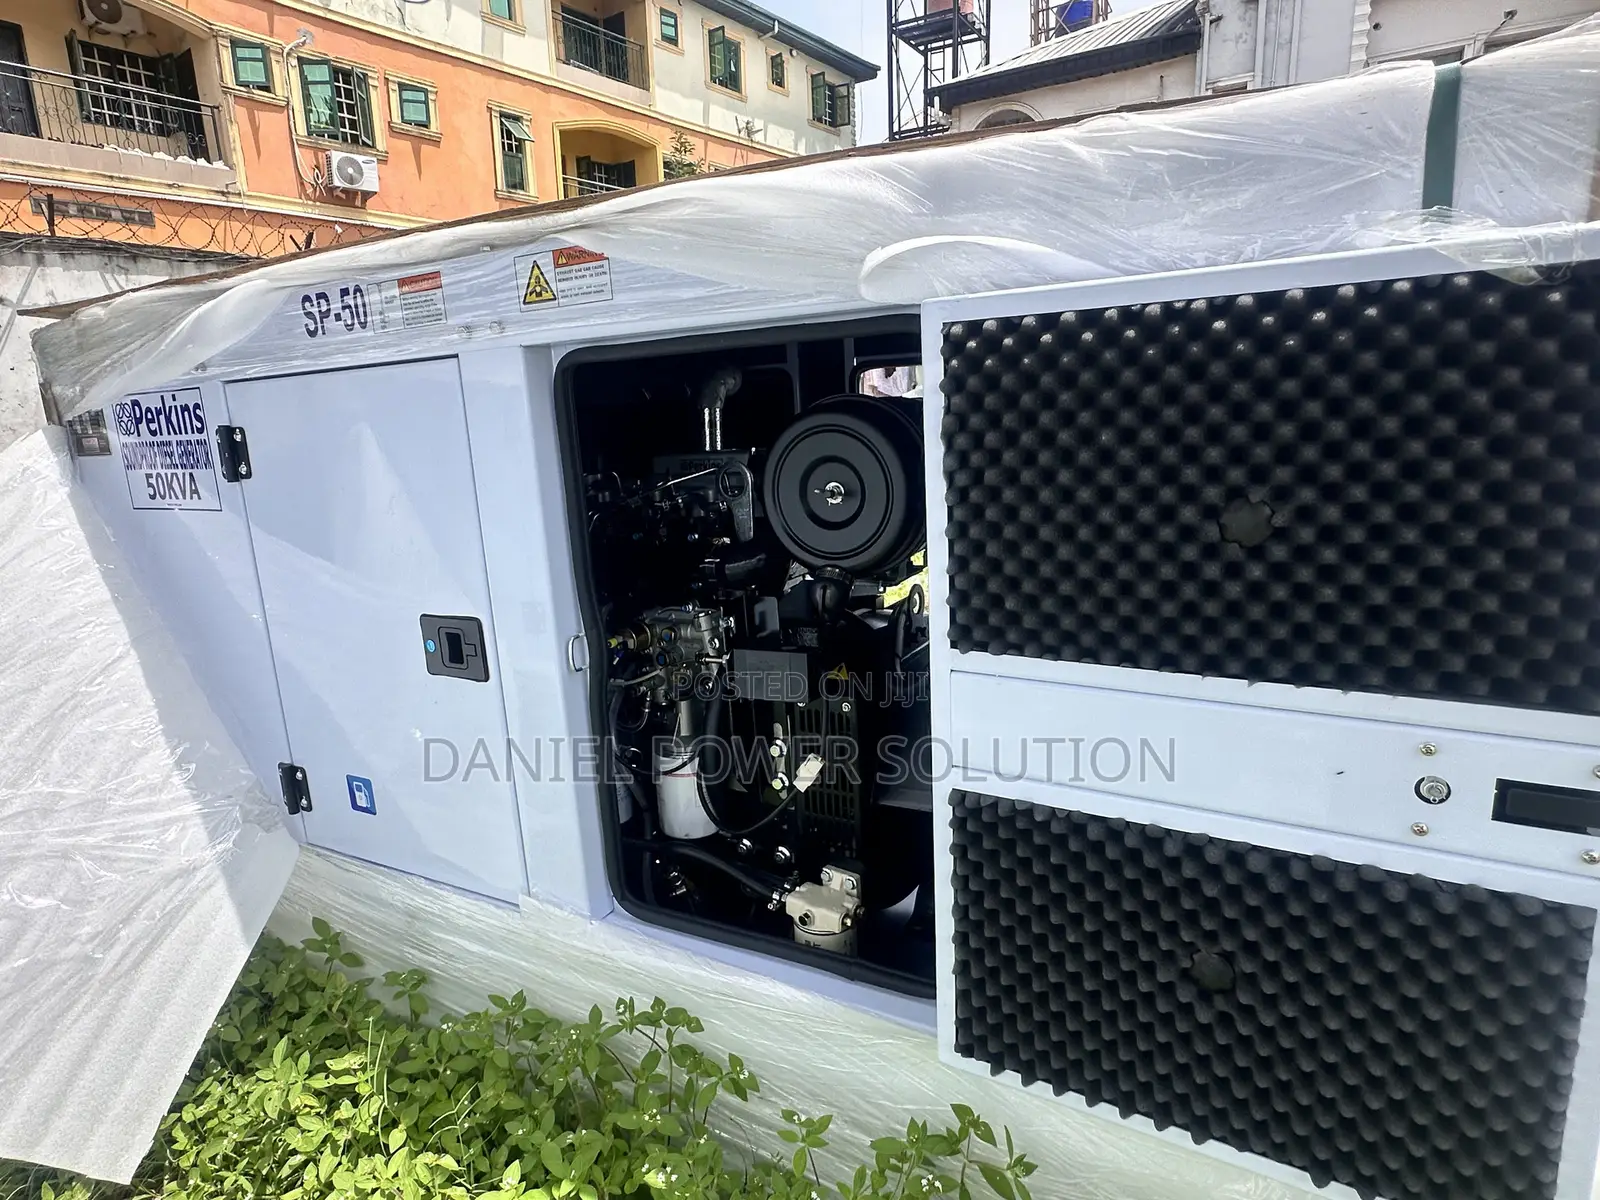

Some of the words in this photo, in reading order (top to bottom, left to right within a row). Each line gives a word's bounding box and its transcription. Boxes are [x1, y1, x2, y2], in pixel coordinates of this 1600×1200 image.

[301, 284, 368, 339] SP-50
[130, 393, 205, 437] Perkins
[145, 471, 202, 501] 50KVA
